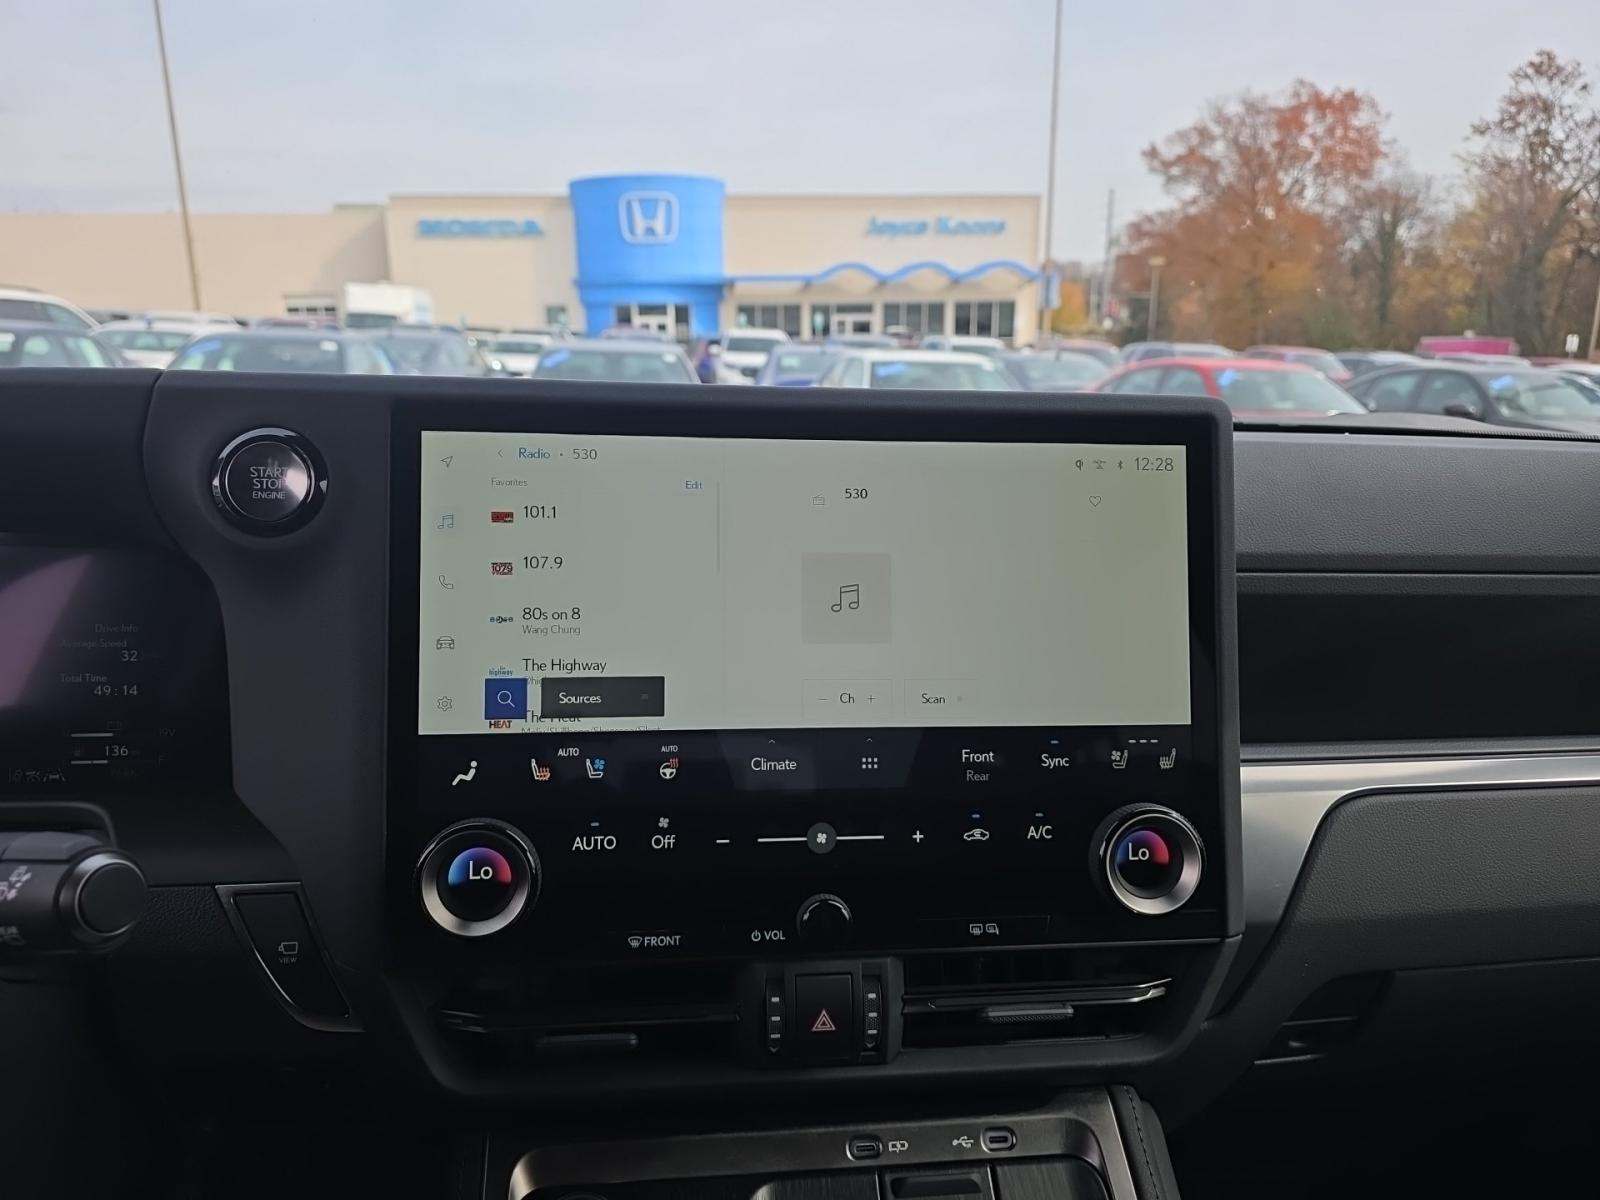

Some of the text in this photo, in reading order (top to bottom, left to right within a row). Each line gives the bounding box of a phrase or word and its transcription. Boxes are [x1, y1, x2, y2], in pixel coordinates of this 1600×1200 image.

[518, 447, 598, 461] Radio 530
[1134, 457, 1174, 472] 12:28
[250, 466, 288, 478] START
[491, 477, 528, 488] Favorites
[685, 480, 703, 491] Edit
[252, 491, 286, 499] ENGINE
[844, 488, 868, 500] 530
[523, 505, 557, 519] 101.1
[523, 556, 563, 569] 107.9
[522, 607, 548, 620] 80s
[551, 611, 568, 620] on
[571, 607, 581, 620] 8
[522, 625, 580, 635] Wang Chung
[121, 650, 138, 662] 32
[522, 658, 607, 674] The Highway
[558, 692, 602, 704] Sources
[839, 692, 855, 704] Ch
[921, 692, 946, 705] Scan
[104, 745, 129, 756] 136
[557, 747, 580, 757] AUTO
[661, 745, 678, 753] AUTO
[961, 749, 994, 763] Front
[1041, 754, 1070, 768] Sync
[750, 757, 797, 771] Climate
[966, 770, 990, 782] Rear
[1027, 825, 1053, 840] A/C
[572, 836, 617, 851] AUTO
[651, 834, 676, 850] Off
[1127, 842, 1150, 861] Lo
[468, 861, 493, 881] Lo
[644, 934, 681, 948] FRONT
[765, 930, 786, 942] VOL
